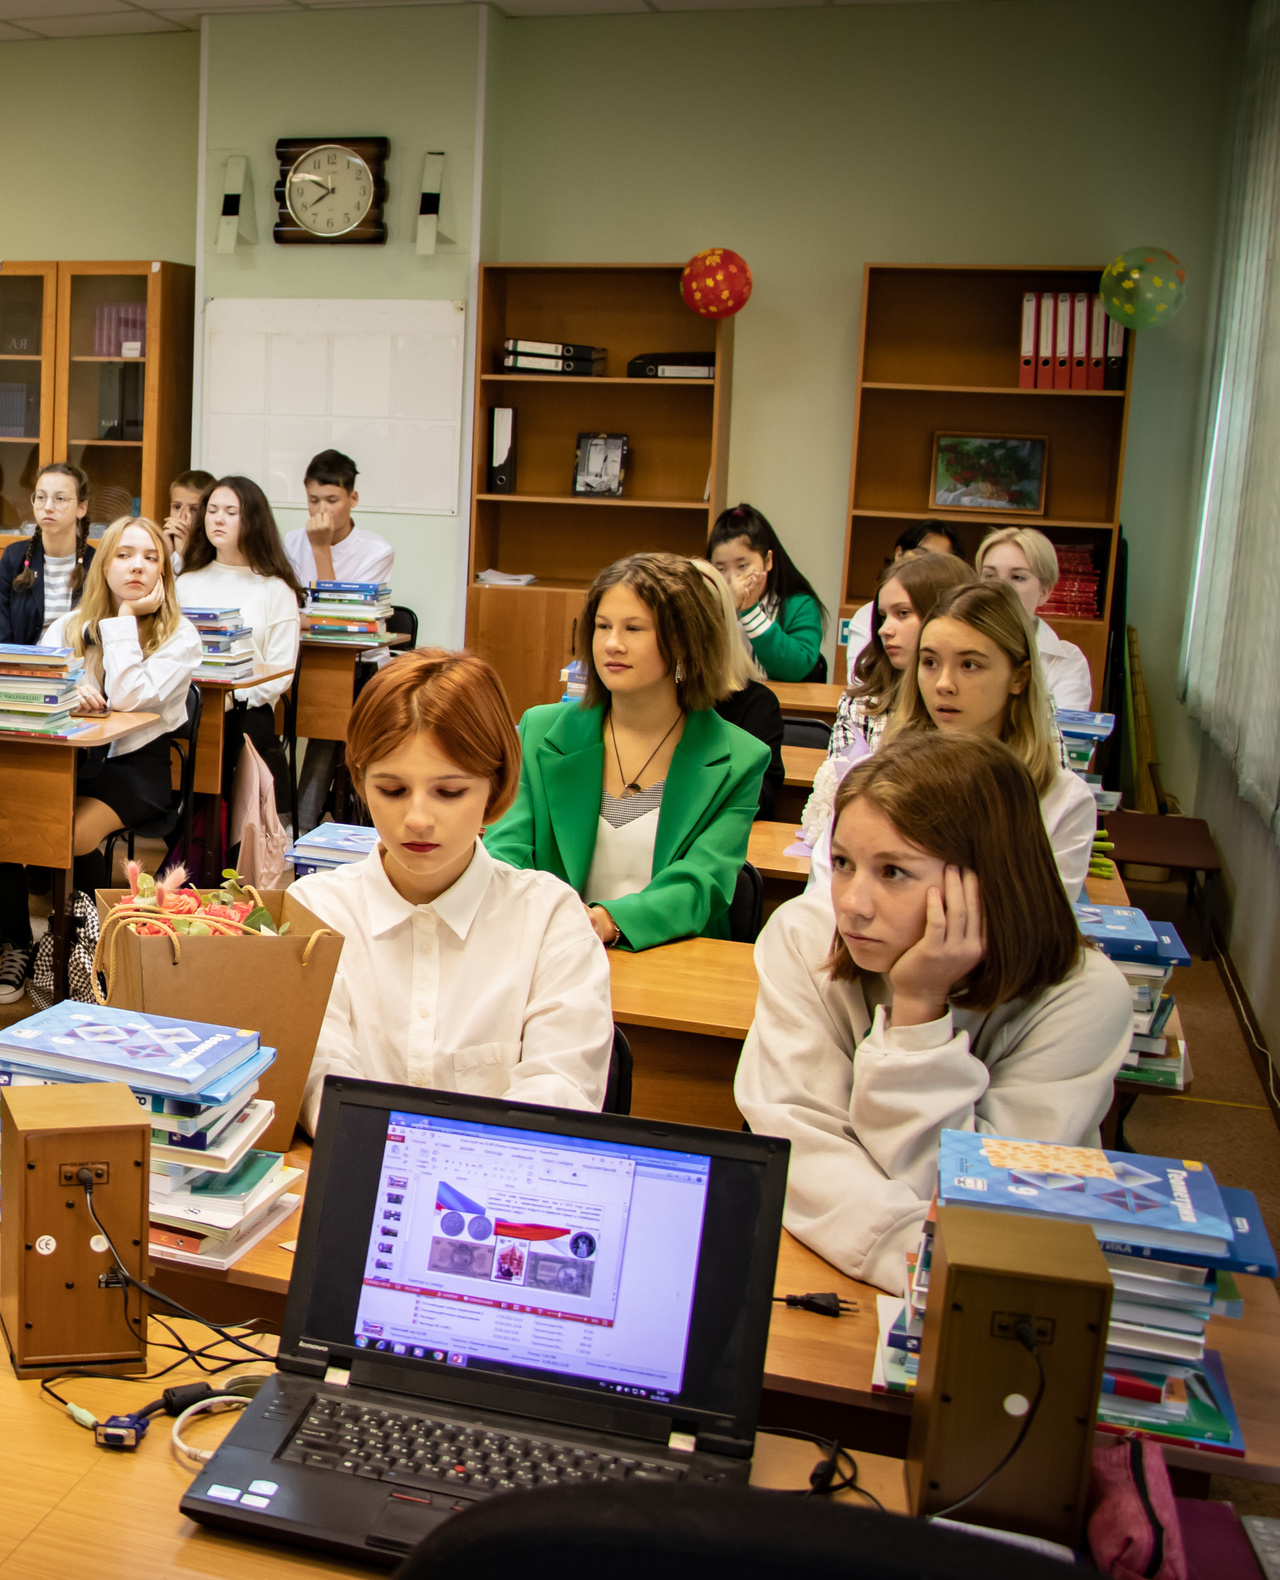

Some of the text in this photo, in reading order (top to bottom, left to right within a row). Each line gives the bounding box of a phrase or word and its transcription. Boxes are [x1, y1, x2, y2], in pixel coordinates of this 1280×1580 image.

[327, 154, 337, 165] 12
[313, 160, 320, 170] 11
[346, 160, 350, 170] 1
[355, 170, 362, 180] 2
[296, 187, 304, 198] 9
[359, 186, 366, 196] 3
[301, 202, 308, 212] 8
[355, 201, 360, 211] 4
[311, 212, 318, 224] 7
[344, 212, 350, 223] 5
[326, 218, 334, 228] 6
[168, 1033, 232, 1069] Геометрия
[1166, 1167, 1198, 1224] Геометрия
